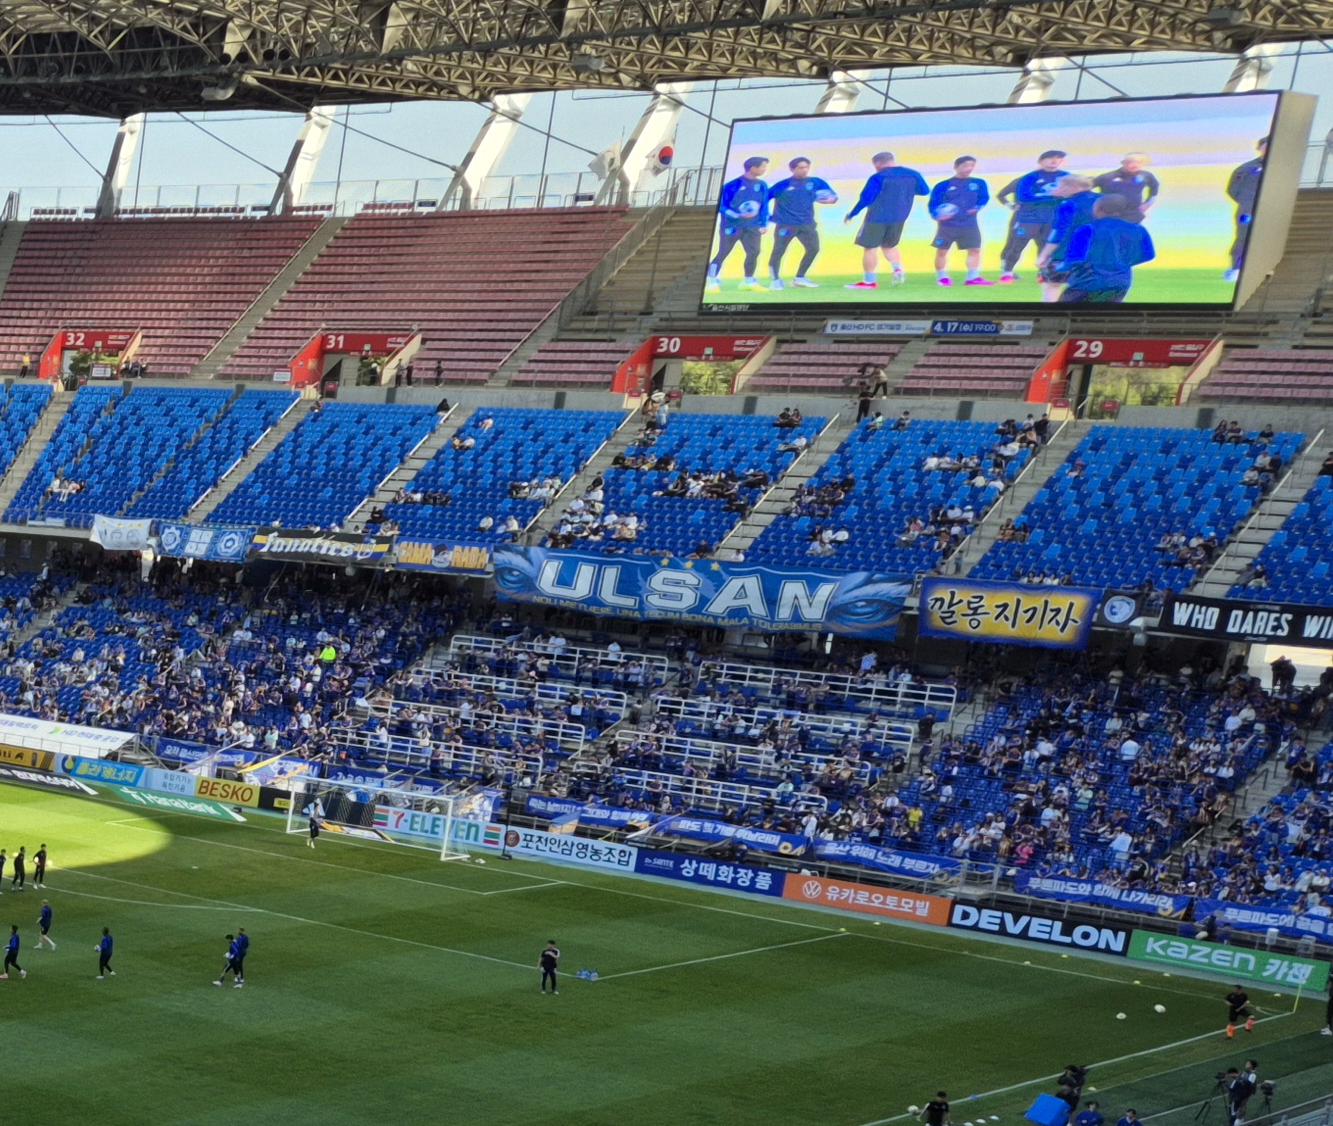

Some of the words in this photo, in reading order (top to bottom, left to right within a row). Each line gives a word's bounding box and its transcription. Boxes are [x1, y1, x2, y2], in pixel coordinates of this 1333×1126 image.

[65, 332, 85, 346] 32
[946, 322, 959, 332] 17
[974, 323, 996, 332] 19:00
[326, 334, 345, 349] 31
[656, 337, 681, 353] 30
[1073, 340, 1104, 359] 29
[259, 531, 355, 558] fanatics
[536, 557, 837, 622] ULSAN
[717, 615, 750, 626] MALA
[1173, 601, 1220, 630] WHO
[1226, 609, 1293, 637] DARES
[197, 778, 254, 804] BESKO
[520, 831, 633, 867] 포천인삼영농조합
[851, 845, 877, 861] 위해
[679, 858, 773, 892] 상떼화장품
[825, 885, 931, 917] 유카로오토모빌
[949, 904, 1127, 953] DEVELON
[1262, 957, 1316, 985] 카젠
